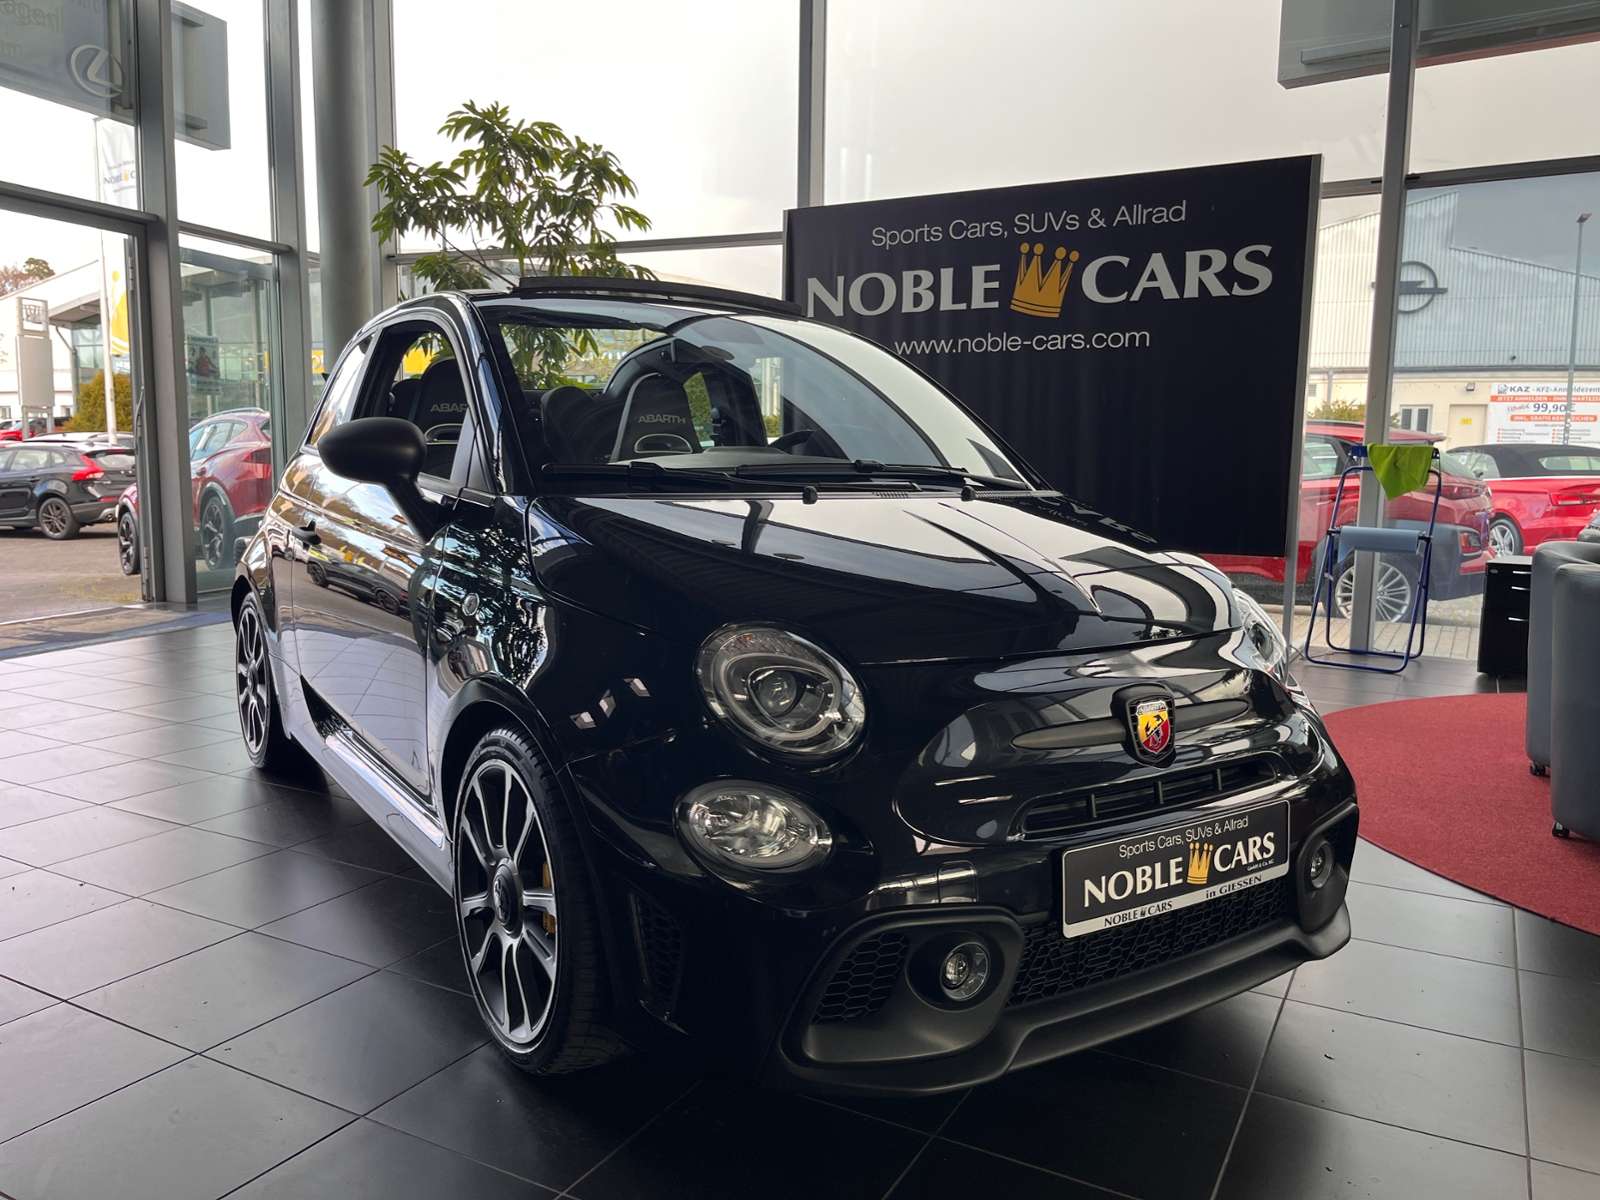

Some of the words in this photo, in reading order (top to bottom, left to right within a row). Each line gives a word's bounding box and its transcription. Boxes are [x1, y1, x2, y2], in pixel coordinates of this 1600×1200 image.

[872, 223, 943, 250] Sports
[949, 219, 1008, 240] Cars,
[1014, 210, 1080, 235] SUVs
[1087, 208, 1106, 229] &
[1113, 199, 1186, 227] Allrad
[807, 264, 1000, 318] NOBLE
[1081, 244, 1273, 304] CARS
[894, 331, 1150, 355] www.noble-cars.com
[638, 414, 686, 423] ABARTH
[1119, 841, 1155, 859] Sports
[1157, 834, 1184, 848] Cars,
[1185, 827, 1213, 842] SUVs
[1214, 823, 1221, 835] &
[1223, 816, 1248, 832] Allrad
[1084, 857, 1184, 907] NOBLE
[1213, 832, 1275, 872] CARS
[1206, 889, 1216, 899] in
[1219, 874, 1262, 895] GIESSEN
[1104, 910, 1138, 927] NOBLE
[1147, 901, 1172, 916] CARS
